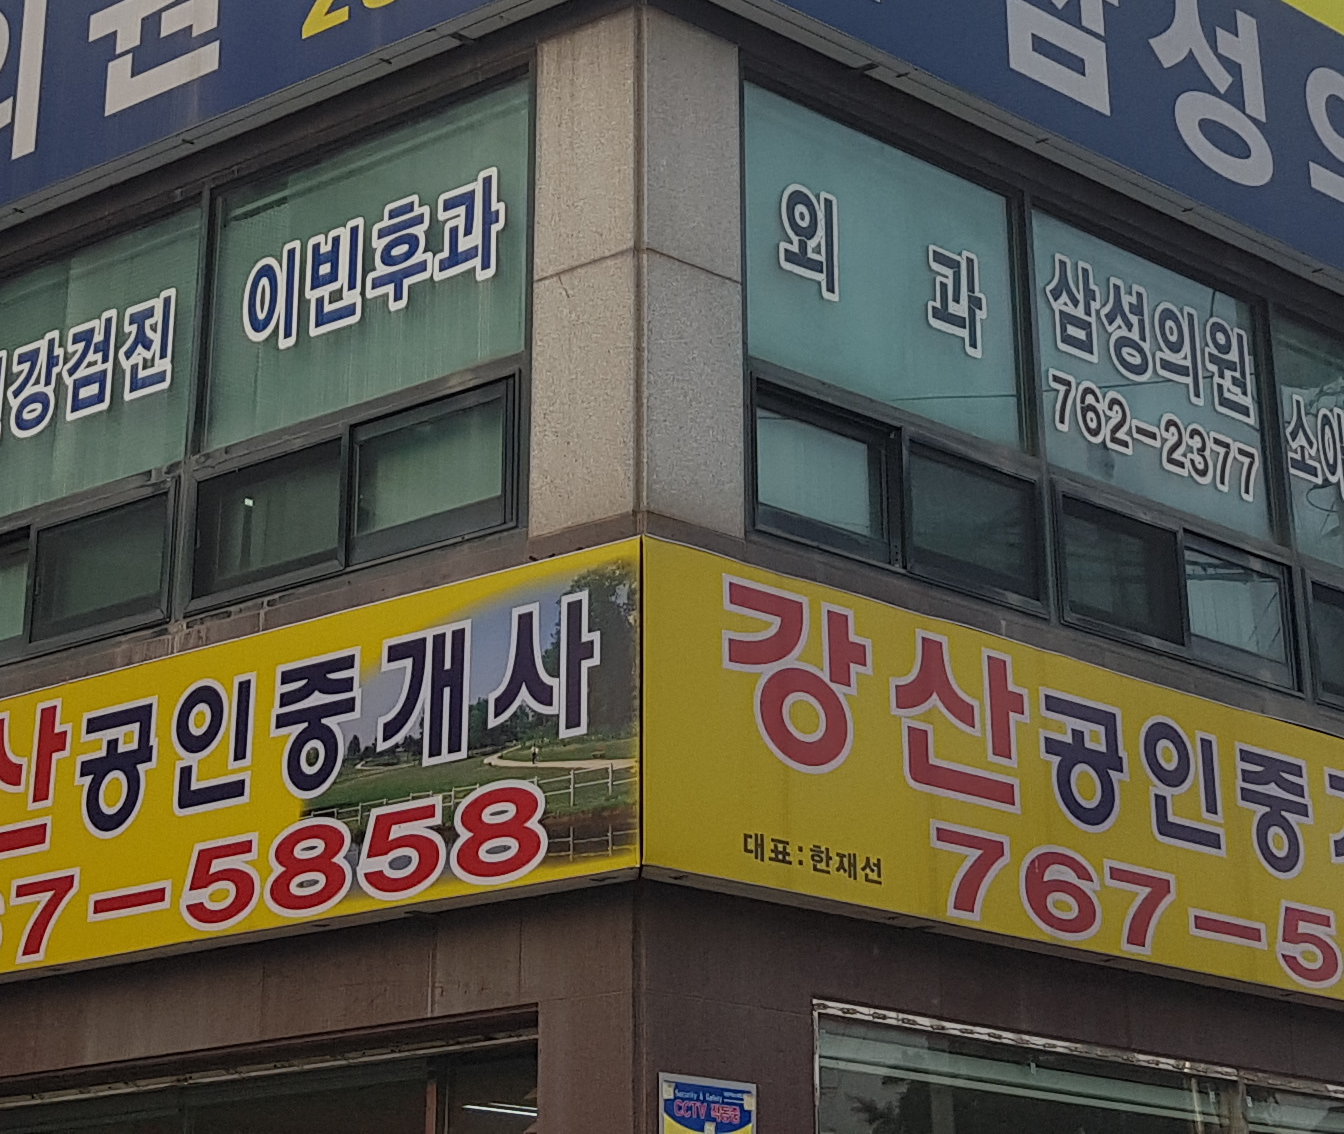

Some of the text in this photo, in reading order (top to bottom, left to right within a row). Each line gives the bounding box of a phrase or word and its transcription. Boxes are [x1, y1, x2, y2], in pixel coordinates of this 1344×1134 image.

[242, 166, 506, 350] 이빈후과
[1044, 252, 1255, 428] 삼성의원
[1048, 368, 1257, 503] 762-2377
[674, 1099, 707, 1120] CCTV
